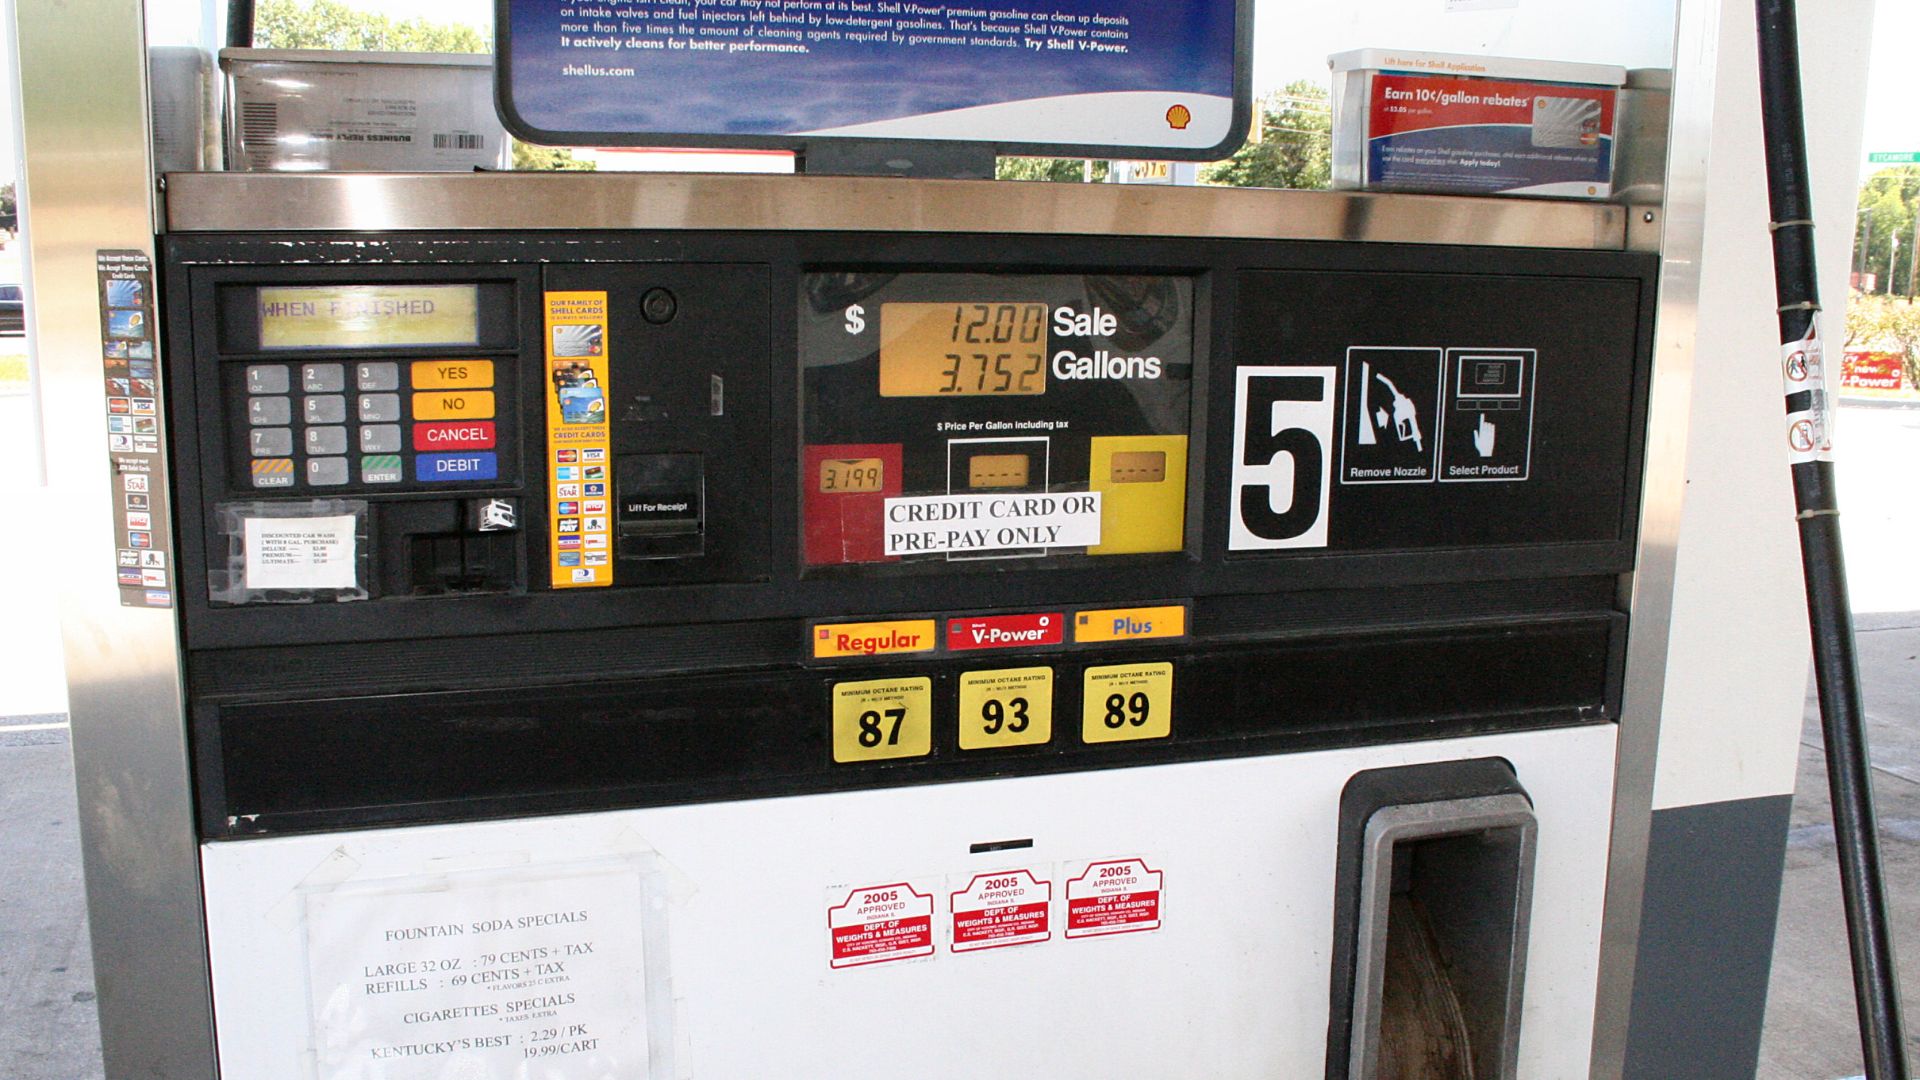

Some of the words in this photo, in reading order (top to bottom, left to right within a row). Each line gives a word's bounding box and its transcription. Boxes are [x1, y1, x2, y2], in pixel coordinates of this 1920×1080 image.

[784, 0, 823, 12] perform
[852, 1, 875, 13] best.
[877, 2, 901, 14] Shell
[947, 8, 987, 19] premium
[990, 9, 1029, 22] gasoline
[1031, 13, 1048, 21] can
[1051, 10, 1076, 22] clean
[1078, 15, 1090, 25] up
[1093, 13, 1130, 26] deposits
[560, 8, 574, 17] on
[579, 7, 613, 18] intake
[616, 7, 649, 19] valves
[654, 8, 675, 19] and
[678, 8, 698, 20] fuel
[702, 9, 746, 23] injectors
[749, 10, 766, 22] left
[769, 11, 805, 23] behind
[809, 12, 821, 27] by
[825, 12, 893, 30] low-detergent
[896, 18, 946, 32] gasolines.
[950, 19, 978, 32] That's
[981, 21, 1021, 34] because
[1024, 22, 1047, 35] Shell
[1050, 25, 1088, 38] V-Power
[1091, 28, 1129, 39] contains
[561, 23, 589, 32] more
[594, 21, 617, 32] than
[622, 21, 641, 33] five
[647, 23, 674, 35] times
[679, 23, 695, 35] the
[700, 25, 739, 36] amount
[743, 24, 754, 37] of
[759, 25, 803, 40] cleaning
[807, 29, 841, 42] agents
[845, 31, 888, 44] required
[892, 33, 905, 45] by
[909, 34, 966, 48] government
[971, 36, 1022, 49] standards.
[1024, 38, 1043, 51] Try
[1047, 39, 1075, 52] Shell
[1079, 40, 1130, 54] V-Power.
[562, 36, 571, 47] It
[574, 36, 621, 51] actively
[626, 37, 664, 49] cleans
[668, 38, 686, 49] for
[690, 38, 726, 51] better
[729, 41, 810, 55] performance.
[563, 65, 635, 77] shellus.com
[1385, 87, 1414, 101] Earn
[1416, 89, 1480, 106] 10¢/gallon
[1459, 158, 1478, 169] Apply
[1480, 158, 1502, 169] today!
[263, 302, 315, 317] WHEN
[330, 300, 435, 316] FNISHED
[551, 307, 573, 315] SHELL
[845, 303, 866, 336] $
[951, 304, 1045, 345] 12.00
[1053, 306, 1117, 338] Sale
[1052, 350, 1162, 381] Gallons
[251, 370, 258, 380] 1
[307, 368, 314, 379] 2
[362, 368, 370, 378] 3
[438, 366, 469, 380] YES
[940, 353, 1042, 394] 3.752
[253, 401, 261, 412] 4
[308, 400, 316, 411] 5
[363, 399, 371, 410] 6
[443, 398, 466, 411] NO
[937, 421, 943, 432] $
[945, 421, 967, 431] Price
[969, 421, 984, 431] Per
[985, 419, 1013, 431] Gallon
[1015, 420, 1054, 432] including
[1056, 420, 1069, 429] tax
[255, 432, 263, 443] 7
[310, 431, 318, 442] 8
[364, 429, 372, 440] 9
[427, 428, 489, 442] CANCEL
[553, 431, 579, 439] CREDIT
[1240, 375, 1325, 541] 5
[312, 462, 320, 473] 0
[437, 459, 481, 473] DEBIT
[1350, 466, 1393, 479] Remove
[1394, 466, 1427, 478] Nozzle
[1449, 464, 1479, 477] Select
[1481, 464, 1519, 477] Product
[258, 477, 289, 486] CLEAR
[368, 473, 397, 482] ENTER
[825, 468, 879, 490] 3.199
[629, 503, 642, 512] Lift
[643, 503, 657, 512] For
[657, 502, 688, 513] Receipt
[890, 500, 983, 523] CREDIT
[989, 498, 1056, 517] CARD
[1062, 496, 1097, 515] OR
[890, 528, 990, 551] PRE-PAY
[997, 524, 1063, 545] ONLY
[1113, 618, 1153, 636] Plus
[837, 633, 921, 655] Regular
[971, 628, 1045, 646] V-Power
[981, 697, 1030, 736] 93
[1104, 691, 1150, 729] 89
[858, 708, 906, 749] 87
[1099, 866, 1132, 879] 2005
[984, 877, 1018, 891] 2005
[1092, 876, 1139, 889] APPROVED
[863, 890, 898, 905] 2005
[978, 887, 1025, 901] APPROVED
[1098, 896, 1120, 904] DEPT.
[1121, 893, 1132, 902] OF
[857, 901, 906, 915] APPROVED
[984, 908, 1006, 917] DEPT.
[1007, 906, 1019, 914] OF
[1071, 904, 1106, 915] WEIGHTS
[1115, 898, 1156, 911] MEASURES
[385, 923, 464, 942] FOUNTAIN
[471, 918, 514, 934] SODA
[518, 909, 589, 929] SPECIALS
[864, 922, 888, 932] DEPT.
[888, 920, 900, 930] OF
[957, 917, 993, 929] WEIGHTS
[1002, 910, 1046, 923] MEASURES
[836, 932, 874, 944] WEIGHTS
[882, 924, 928, 938] MEASURES
[364, 960, 416, 978] LARGE
[420, 960, 437, 973] 32
[440, 958, 463, 971] OZ
[480, 953, 497, 966] 79
[499, 946, 548, 964] CENTS
[564, 942, 595, 957] TAX
[365, 978, 428, 996] REFILLS
[451, 973, 469, 987] 69
[471, 968, 520, 986] CENTS
[535, 961, 566, 976] TAX
[403, 1004, 498, 1024] CIGARETTES
[506, 992, 576, 1014] SPECIALS
[371, 1037, 471, 1060] KENTUCKY'S
[474, 1034, 513, 1049] BEST
[530, 1028, 558, 1043] 2.29
[568, 1023, 589, 1037] PK
[523, 1038, 601, 1060] 19.99/CART
